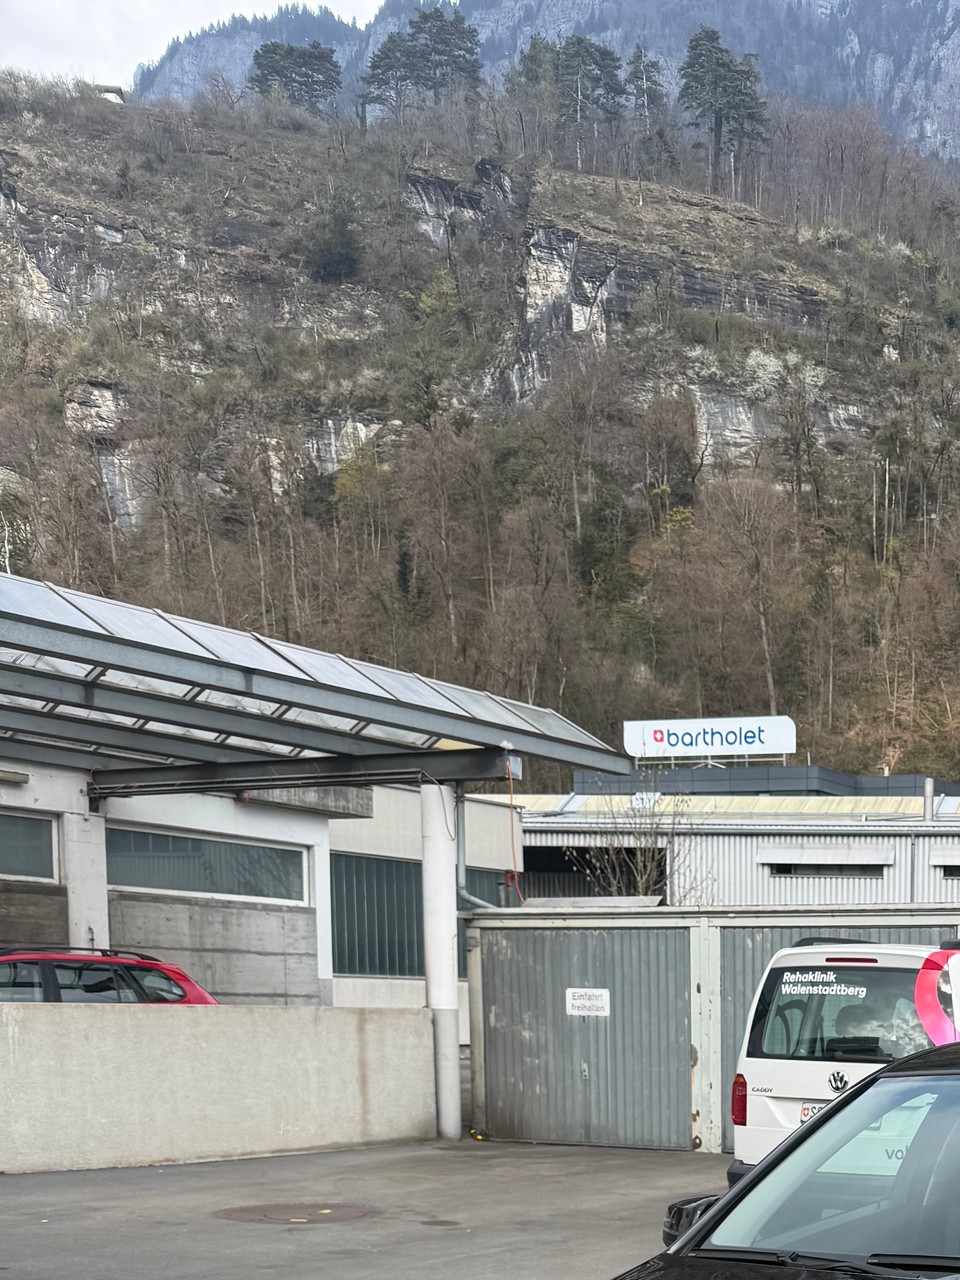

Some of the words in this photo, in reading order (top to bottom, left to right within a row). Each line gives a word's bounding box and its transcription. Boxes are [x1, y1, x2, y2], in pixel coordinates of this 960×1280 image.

[667, 726, 765, 747] bartholet
[783, 971, 837, 983] Rehaklinik
[571, 992, 604, 1001] Einfahrt
[781, 983, 867, 998] Walenstadtberg
